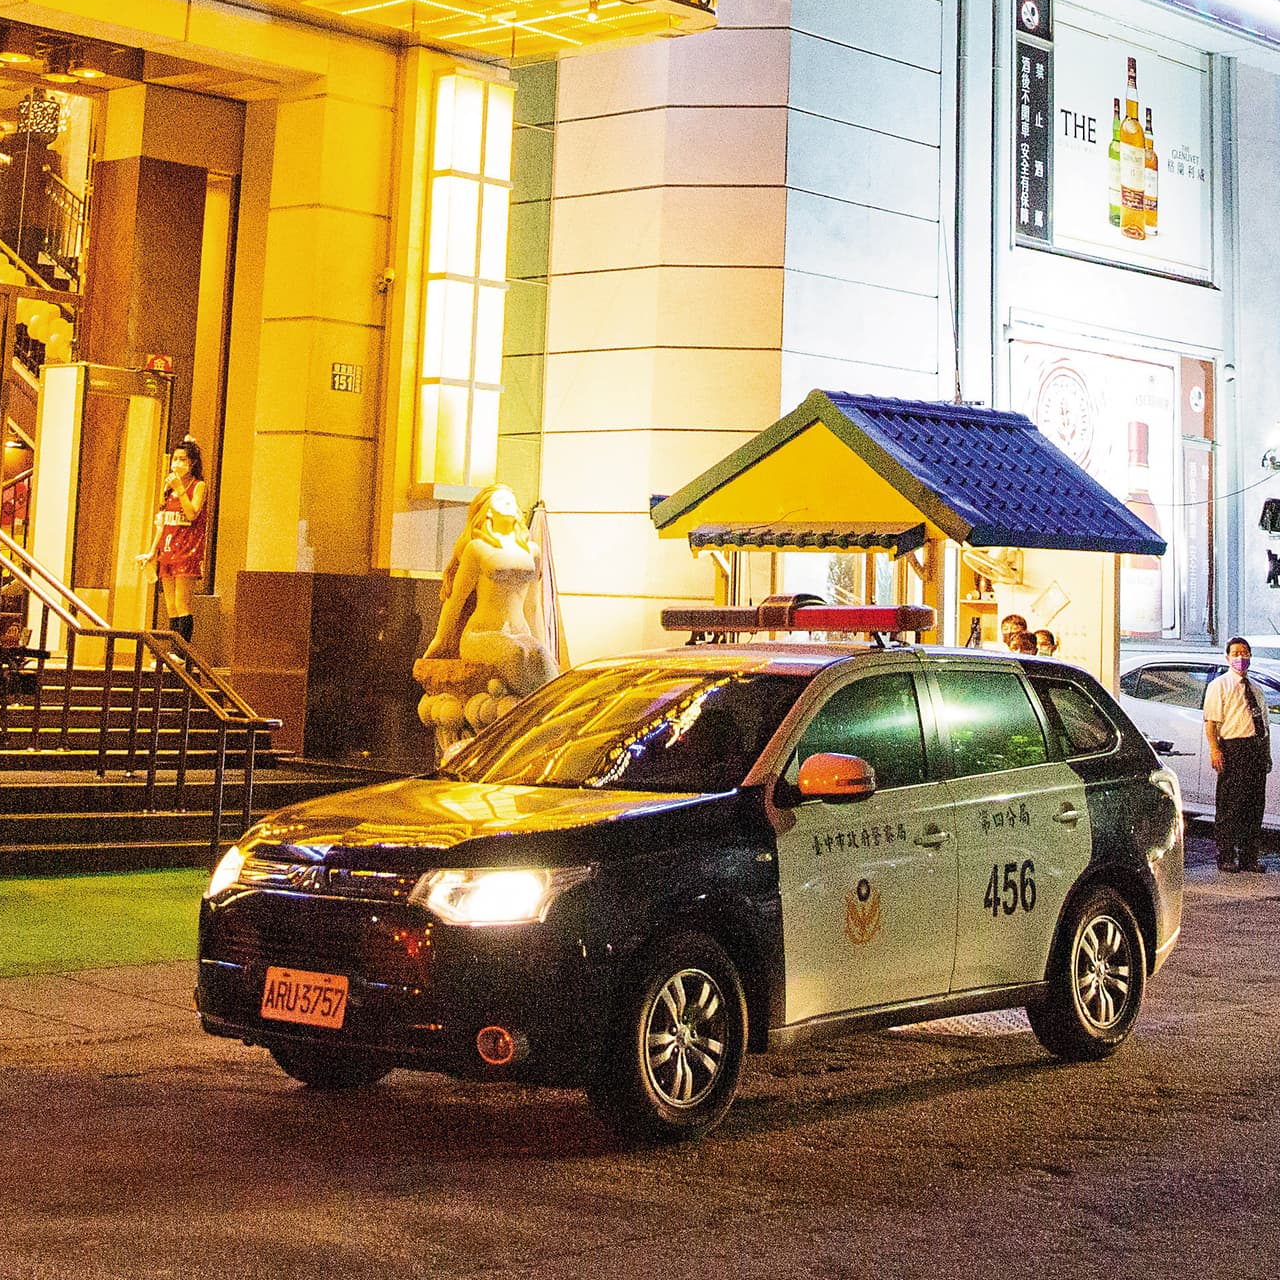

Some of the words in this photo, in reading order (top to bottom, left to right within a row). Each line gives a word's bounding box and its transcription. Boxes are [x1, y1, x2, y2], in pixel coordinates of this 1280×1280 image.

[1060, 109, 1097, 144] THE
[334, 374, 353, 391] 151
[983, 859, 1038, 917] 456
[264, 979, 345, 1018] ARU-3757
